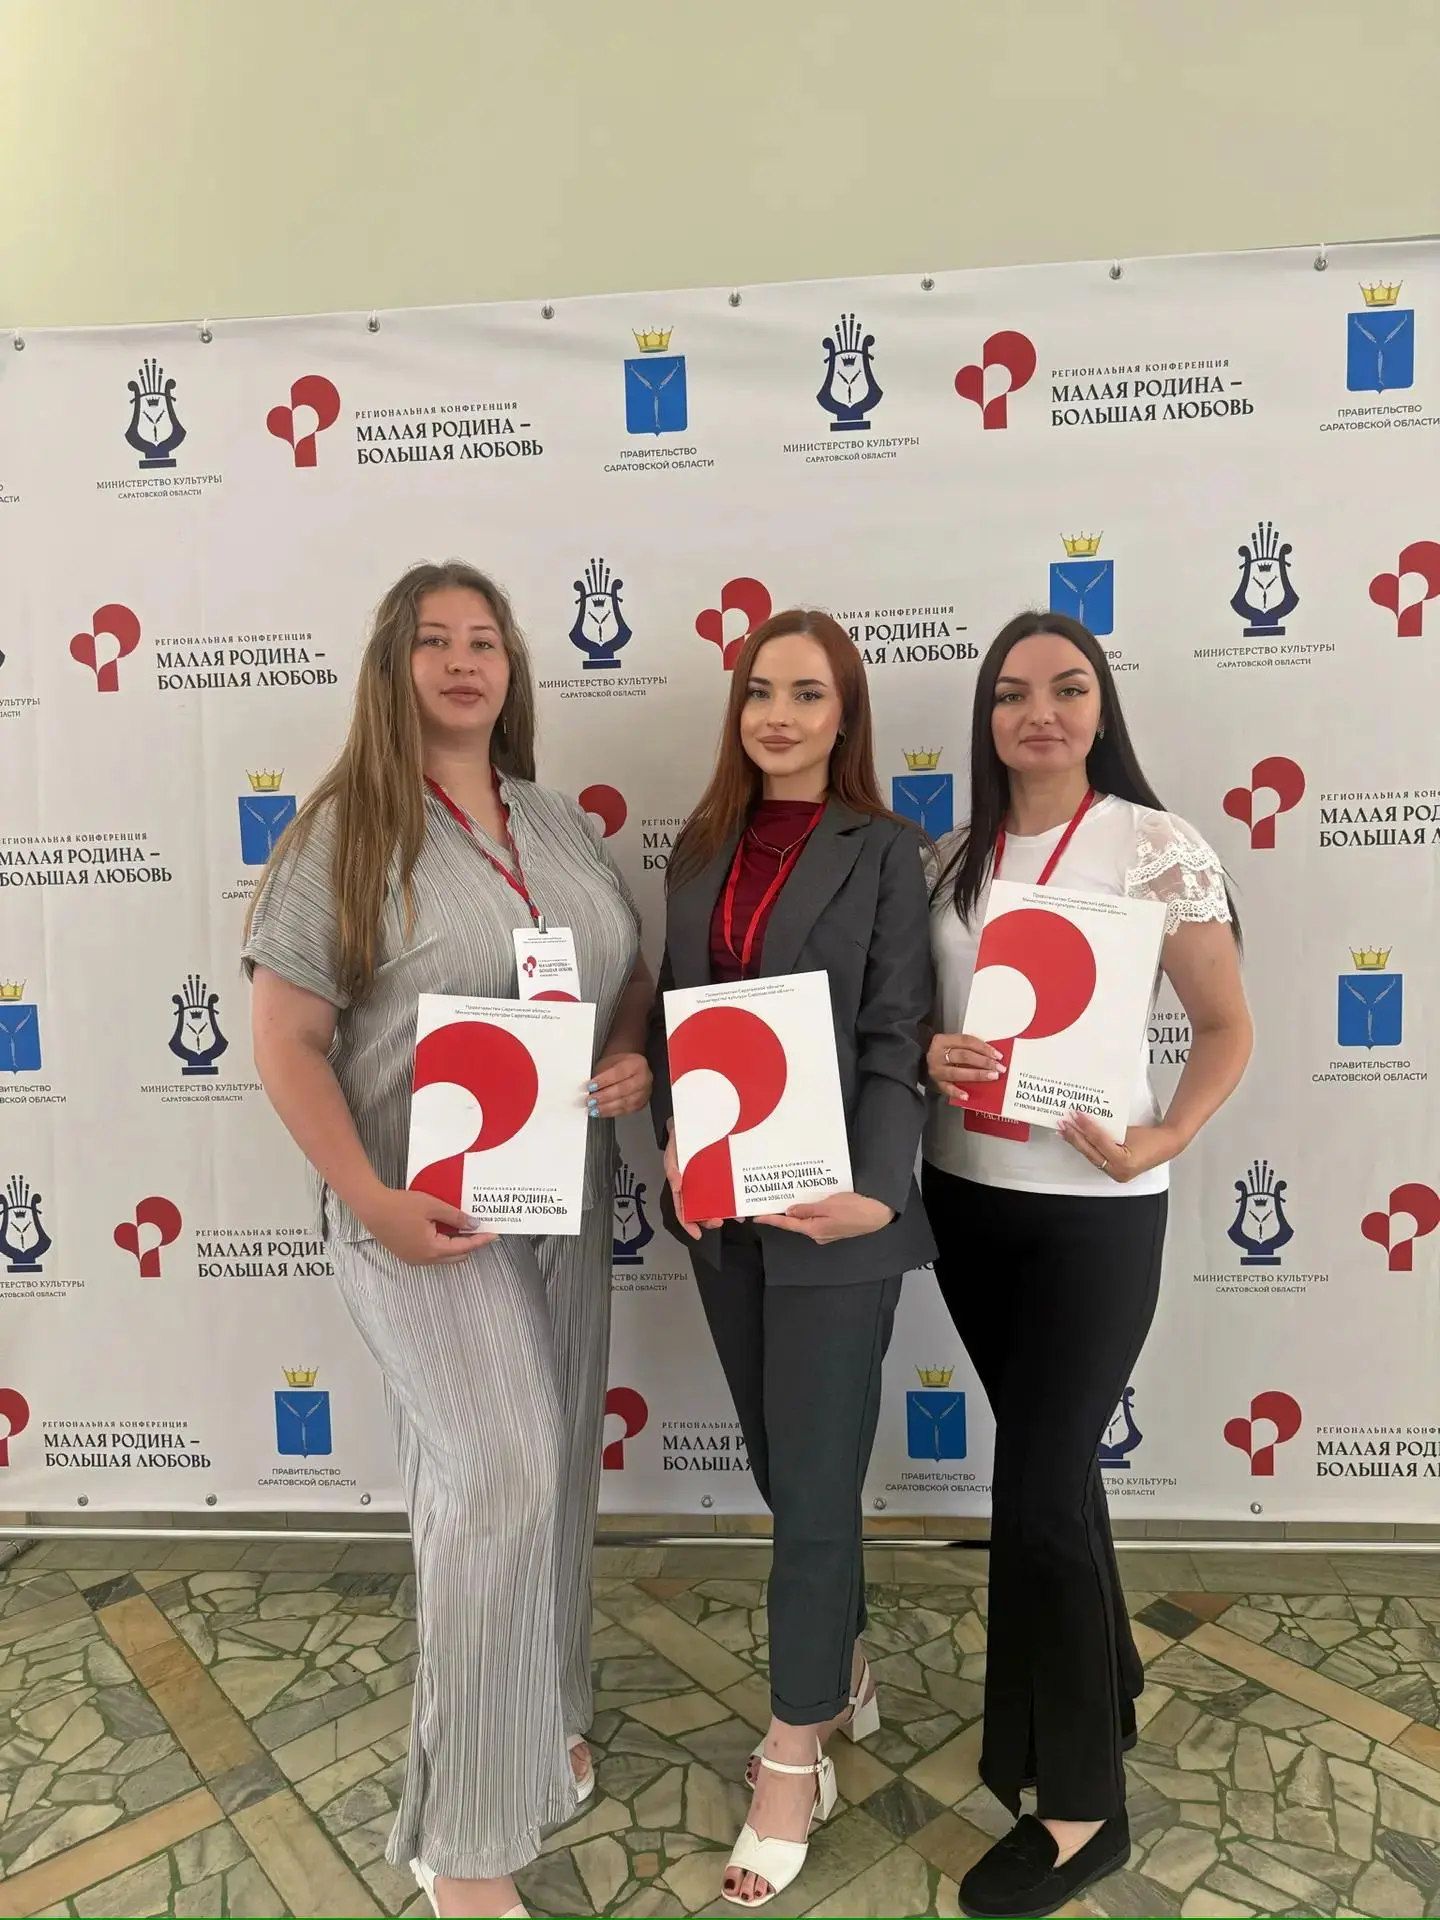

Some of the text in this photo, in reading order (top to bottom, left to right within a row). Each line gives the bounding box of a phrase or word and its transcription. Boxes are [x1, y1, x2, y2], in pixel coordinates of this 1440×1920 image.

[1052, 359, 1229, 378] РЕГИОНАЛЬНАЯ КОНФЕРЕНЦИЯ
[1052, 381, 1128, 403] МАЛАЯ
[1134, 376, 1224, 398] РОДИНА
[355, 402, 517, 419] РЕГИОНАЛЬНАЯ КОНФЕРЕНЦИЯ
[1051, 398, 1254, 426] БОЛЬШАЯ ЛЮБОВЬ
[1338, 404, 1422, 418] ПРАВИТЕЛЬСТВО
[356, 423, 427, 442] МАЛАЯ
[432, 418, 515, 439] РОДИНА
[1320, 417, 1440, 432] САРАТОВСКОЙ ОБЛАСТИ
[783, 437, 919, 453] МИНИСТЕРСТВО КУЛЬТУРЫ
[357, 440, 543, 464] БОЛЬШАЯ ЛЮБОВЬ
[620, 447, 697, 459] ПРАВИТЕЛЬСТВО
[805, 451, 896, 463] САРАТОВСКОЙ ОБЛАСТИ
[604, 459, 714, 472] САРАТОВСКОЙ ОБЛАСТИ
[96, 474, 222, 489] МИНИСТЕРСТВО КУЛЬТУРЫ
[118, 488, 202, 499] САРАТОВСКОЙ ОБЛАСТИ
[875, 606, 954, 618] КОНФЕРЕНЦИЯ
[865, 621, 950, 641] РОДИНА
[155, 633, 312, 646] РЕГИОНАЛЬНАЯ КОНФЕРЕНЦИЯ
[892, 643, 979, 663] ЛЮБОВЬ
[1194, 643, 1335, 658] МИНИСТЕРСТВО КУЛЬТУРЫ
[157, 650, 225, 668] МАЛАЯ
[229, 647, 310, 667] РОДИНА
[1217, 658, 1311, 668] САРАТОВСКОЙ ОБЛАСТИ
[157, 669, 338, 690] БОЛЬШАЯ ЛЮБОВЬ
[539, 676, 667, 688] МИНИСТЕРСТВО КУЛЬТУРЫ
[560, 689, 612, 698] САРАТОВСКОЙ
[0, 698, 40, 706] УЛЬТУРЫ
[1320, 791, 1409, 801] РЕГИОНАЛЬНАЯ
[1320, 806, 1397, 824] МАЛАЯ
[1, 832, 147, 845] ЕГИОНАЛЬНАЯ КОНФЕРЕНЦИЯ
[1320, 828, 1426, 847] БОЛЬШАЯ
[0, 849, 63, 866] МАЛАЯ
[68, 847, 145, 865] РОДИНА
[0, 867, 172, 887] БОЛЬШАЯ ЛЮБОВЬ
[1330, 1060, 1411, 1069] ПРАВИТЕЛЬСТВО
[1312, 1072, 1427, 1082] САРАТОВСКОЙ ОБЛАСТИ
[0, 1085, 51, 1093] ВИТЕЛЬСТВО
[140, 1083, 263, 1093] МИНИСТЕРСТВО КУЛЬТУРЫ
[1017, 1080, 1055, 1095] МАЛАЯ
[1056, 1088, 1101, 1105] РОДИНА
[161, 1095, 210, 1103] САРАТОВСКОЙ
[1015, 1090, 1114, 1119] БОЛЬШАЯ ЛЮБОВЬ
[743, 1171, 780, 1183] МАЛАЯ
[781, 1167, 824, 1179] РОДИНА
[796, 1176, 839, 1189] ЛЮБОВЬ
[473, 1193, 510, 1203] МАЛАЯ
[512, 1194, 554, 1203] РОДИНА
[472, 1204, 568, 1215] БОЛЬШАЯ ЛЮБОВЬ
[195, 1229, 272, 1237] РЕГИОНАЛЬНАЯ
[197, 1242, 263, 1257] МАЛАЯ
[198, 1262, 288, 1278] БОЛЬШАЯ
[640, 1273, 688, 1281] КУЛЬТУРЫ
[1193, 1274, 1328, 1283] МИНИСТЕРСТВО КУЛЬТУРЫ
[39, 1280, 85, 1288] КУЛЬТУРЫ
[635, 1284, 667, 1292] ОБЛАСТИ
[1216, 1285, 1270, 1293] САРАТОВСКОЙ
[1317, 1426, 1401, 1434] РЕГИОНАЛЬНАЯ
[44, 1433, 107, 1448] МАЛАЯ
[111, 1433, 185, 1450] РОДИНА
[663, 1435, 730, 1451] МАЛАЯ
[1317, 1441, 1390, 1456] МАЛАЯ
[45, 1453, 211, 1468] БОЛЬШАЯ ЛЮБОВЬ
[272, 1468, 341, 1476] ПРАВИТЕЛЬСТВО
[1317, 1462, 1417, 1477] БОЛЬШАЯ
[258, 1478, 356, 1487] САРАТОВСКОЙ ОБЛАСТИ
[901, 1473, 976, 1481] ПРАВИТЕЛЬСТВО
[1126, 1478, 1177, 1486] КУЛЬТУРЫ
[885, 1483, 992, 1493] САРАТОВСКОЙ ОБЛАСТИ
